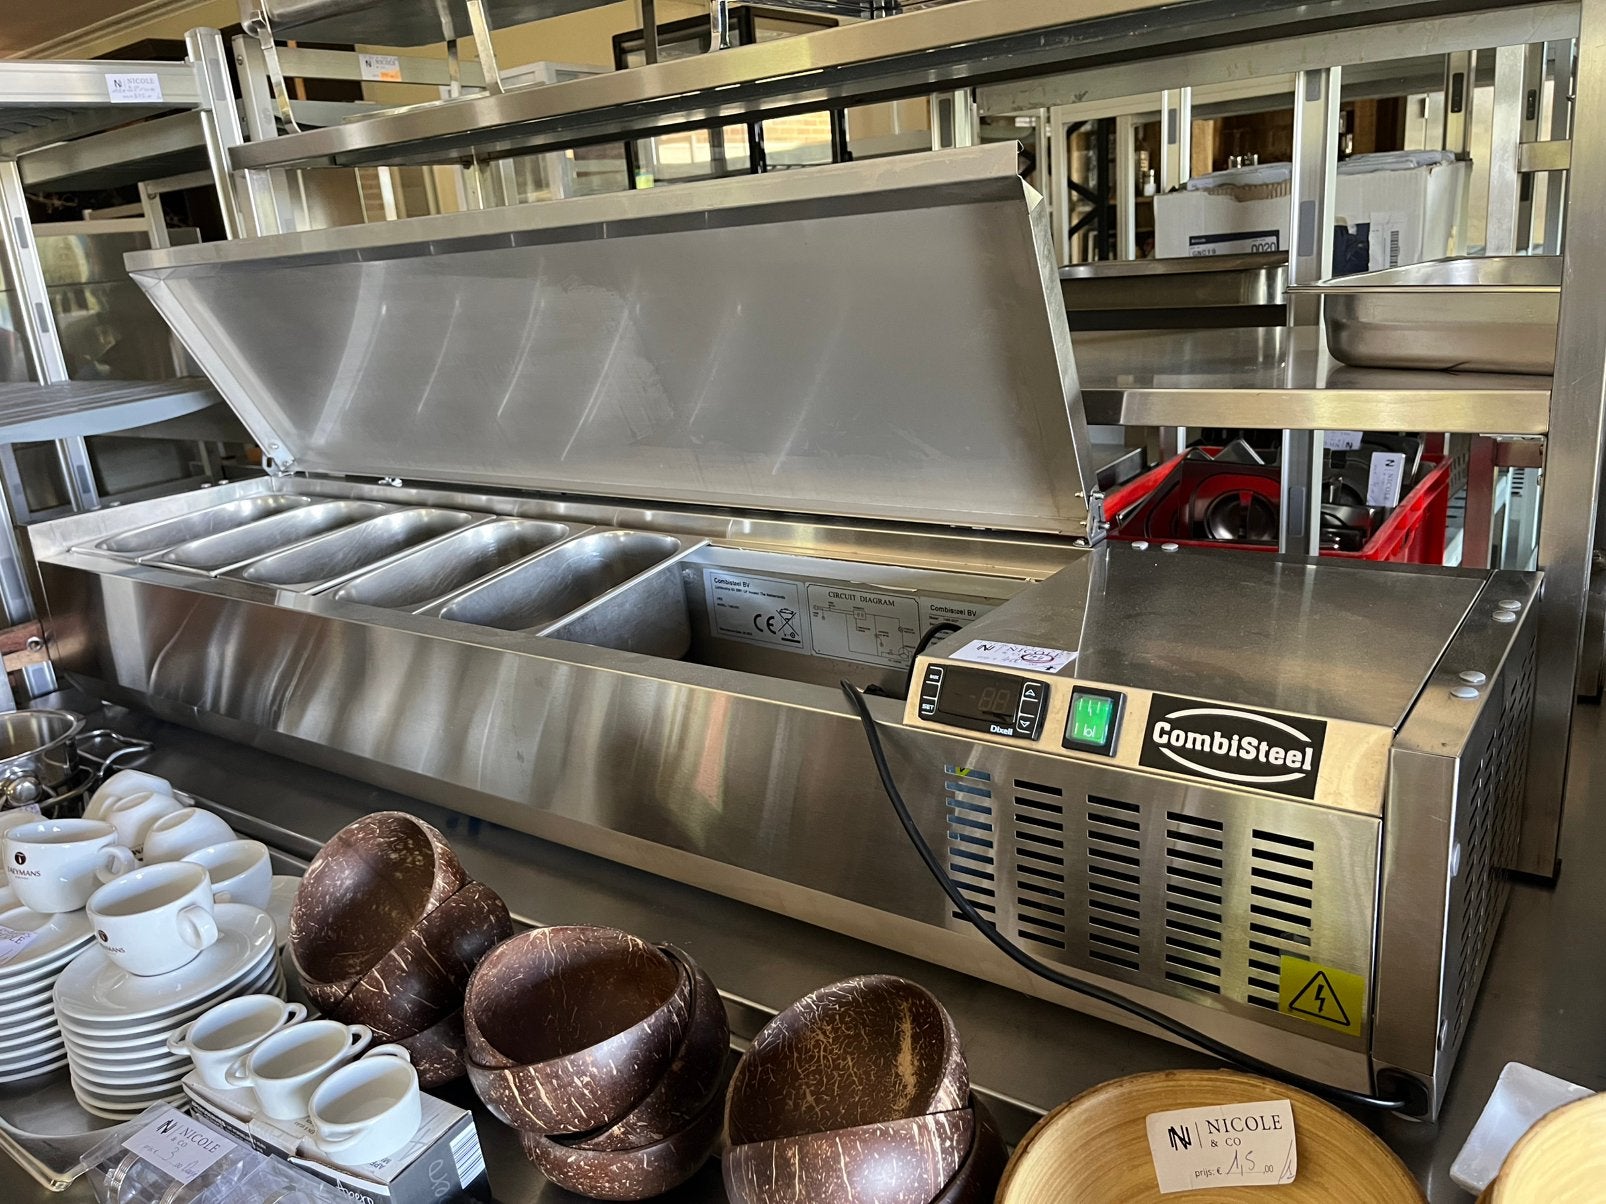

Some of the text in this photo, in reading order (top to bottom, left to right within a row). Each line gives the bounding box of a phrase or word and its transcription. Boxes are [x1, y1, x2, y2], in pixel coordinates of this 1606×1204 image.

[828, 591, 896, 607] CIRCUIT DIAGRAM
[930, 604, 977, 617] Combisteel BV
[990, 724, 1014, 736] Dixell
[1152, 721, 1314, 771] CombiSteel
[1205, 1114, 1283, 1135] NICOLE
[179, 1127, 221, 1154] NICOLE
[1210, 1137, 1242, 1148] & CO
